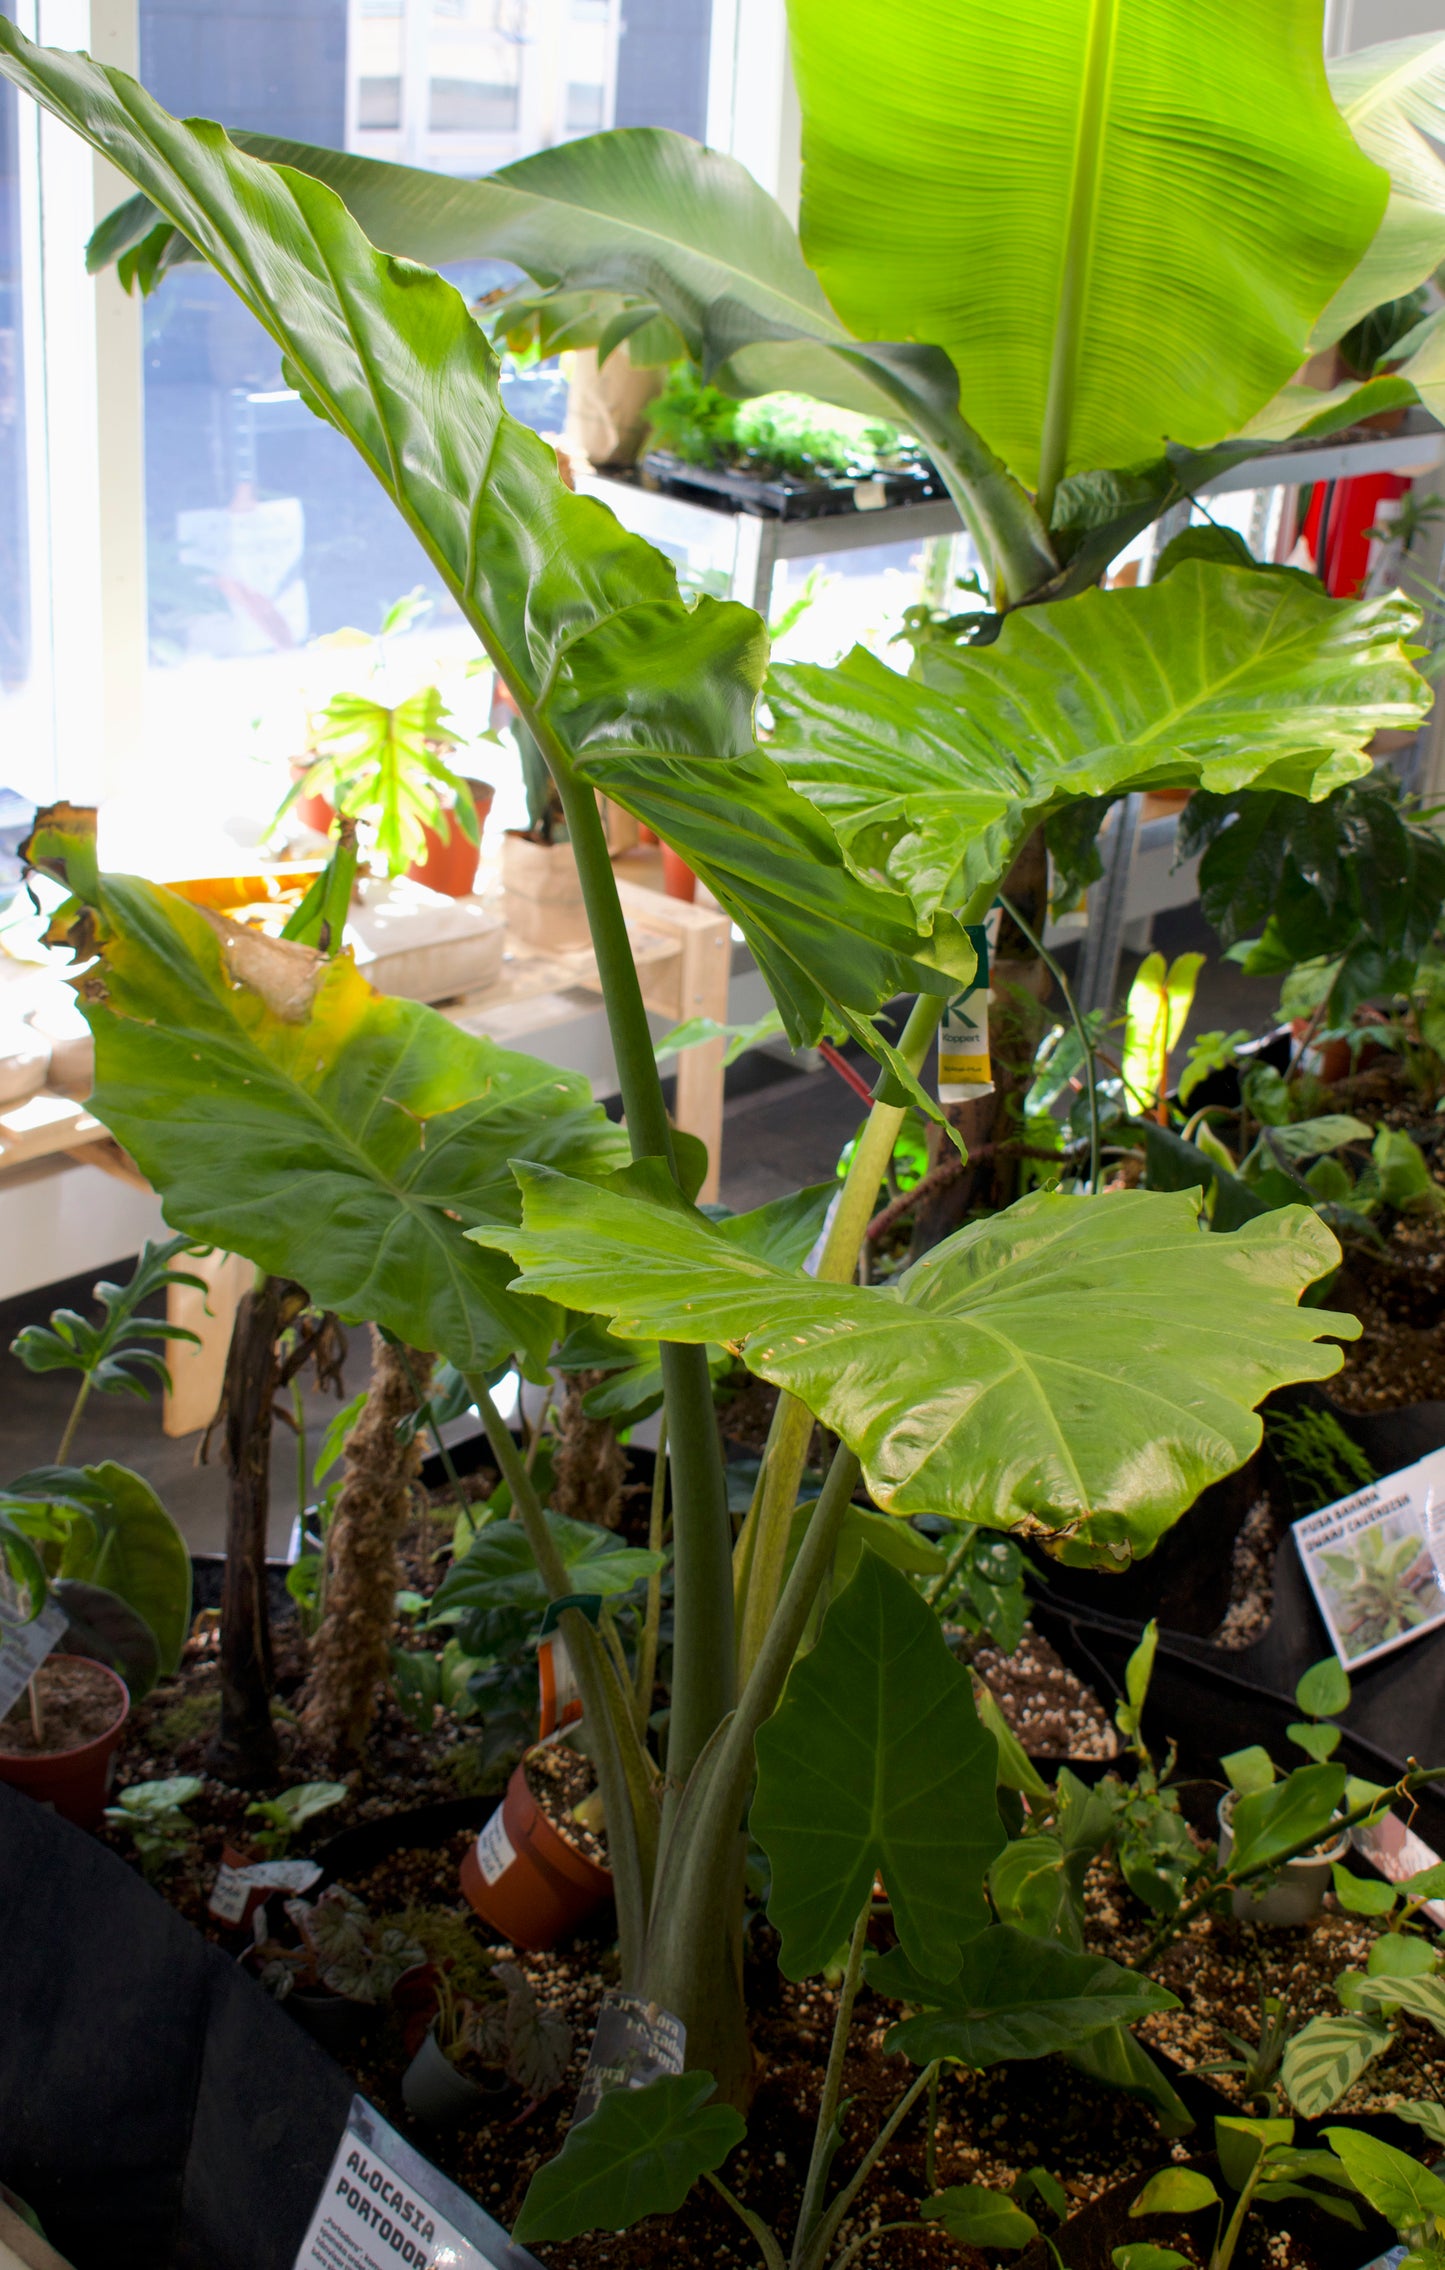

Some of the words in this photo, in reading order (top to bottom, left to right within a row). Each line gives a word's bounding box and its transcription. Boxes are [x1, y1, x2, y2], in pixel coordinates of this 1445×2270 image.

[942, 1032, 980, 1043] Koppert
[1304, 1525, 1344, 1552] DWARF
[1346, 1493, 1410, 1533] CAVENDISH
[336, 2177, 436, 2270] PORTODOR
[347, 2151, 435, 2243] ALOCASIA
